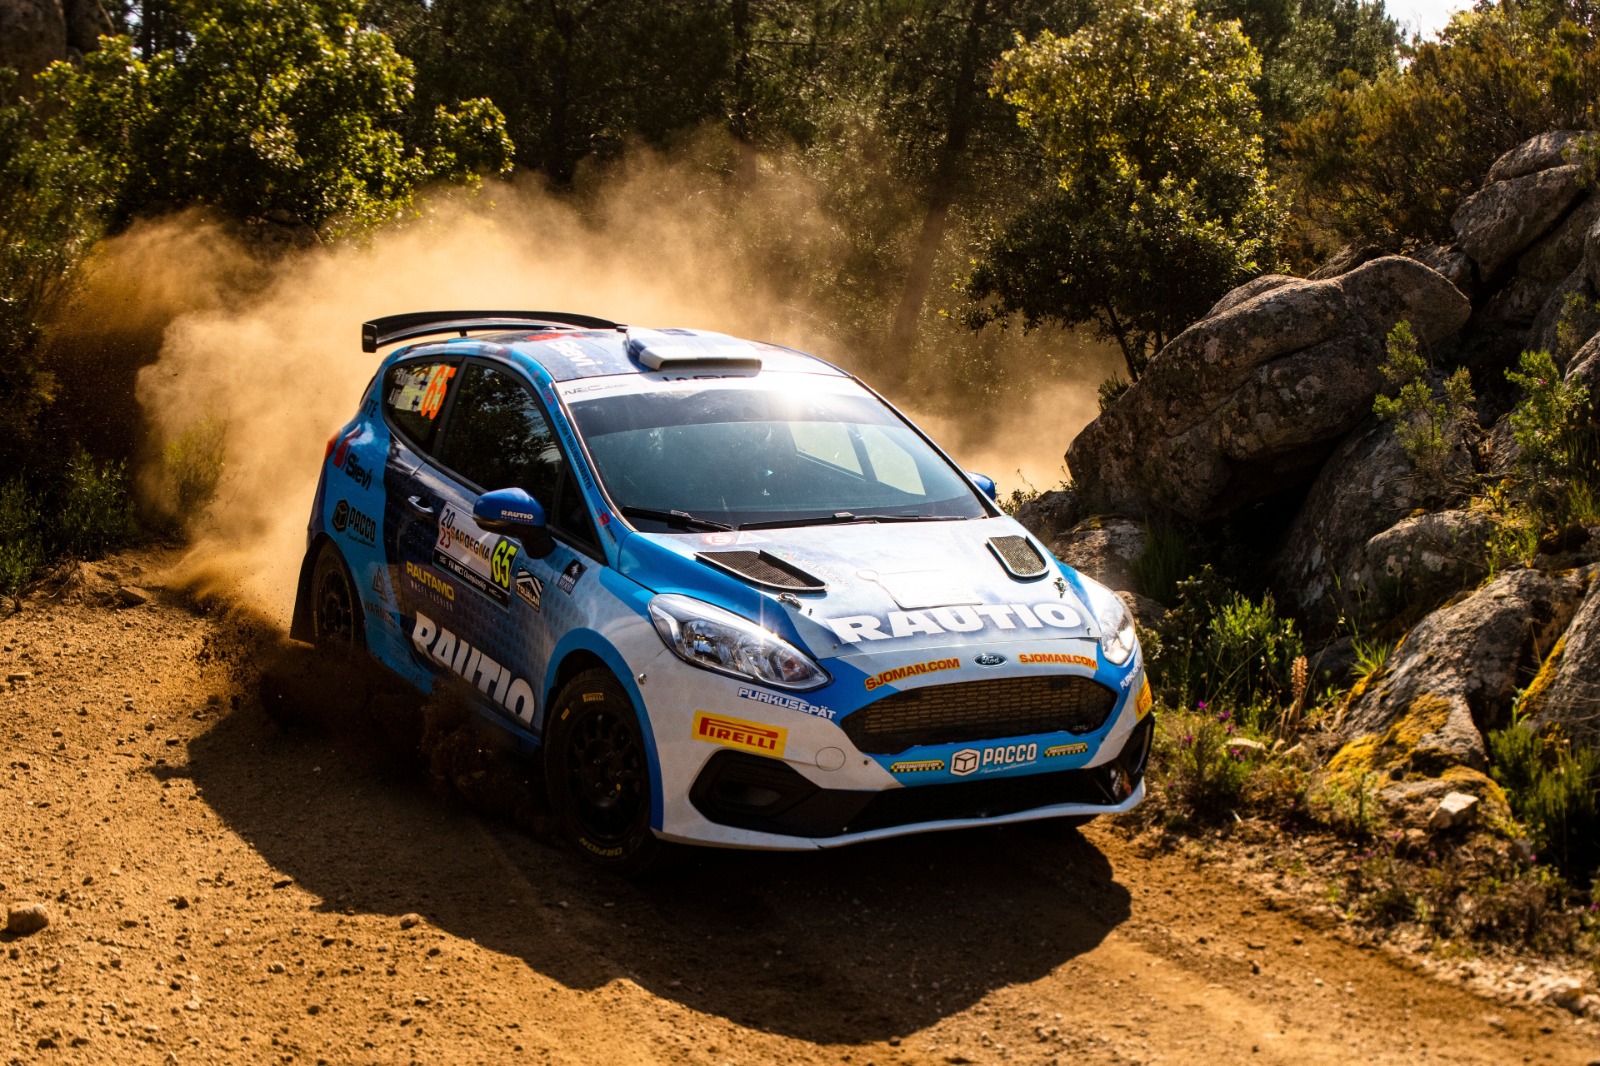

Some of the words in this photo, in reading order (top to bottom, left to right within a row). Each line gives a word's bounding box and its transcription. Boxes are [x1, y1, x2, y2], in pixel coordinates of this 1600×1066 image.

[421, 364, 457, 419] 65
[346, 454, 373, 490] Sievi
[348, 507, 376, 542] PACCO
[441, 508, 455, 528] 20
[501, 509, 534, 520] RAUTIO
[440, 527, 452, 549] 23
[450, 526, 491, 562] SARDEGNA
[406, 561, 455, 601] RAUTAMO
[491, 540, 517, 589] 65
[826, 603, 1082, 645] RAUTIO
[412, 610, 535, 729] RAUTIO
[865, 657, 960, 691] SJOMAN.COM
[981, 655, 1000, 665] Ford
[1019, 653, 1098, 670] SJOMAN.COM
[738, 687, 837, 720] PURKUSEPÄT
[699, 717, 779, 751] PIRELLI
[983, 743, 1037, 766] PACCO
